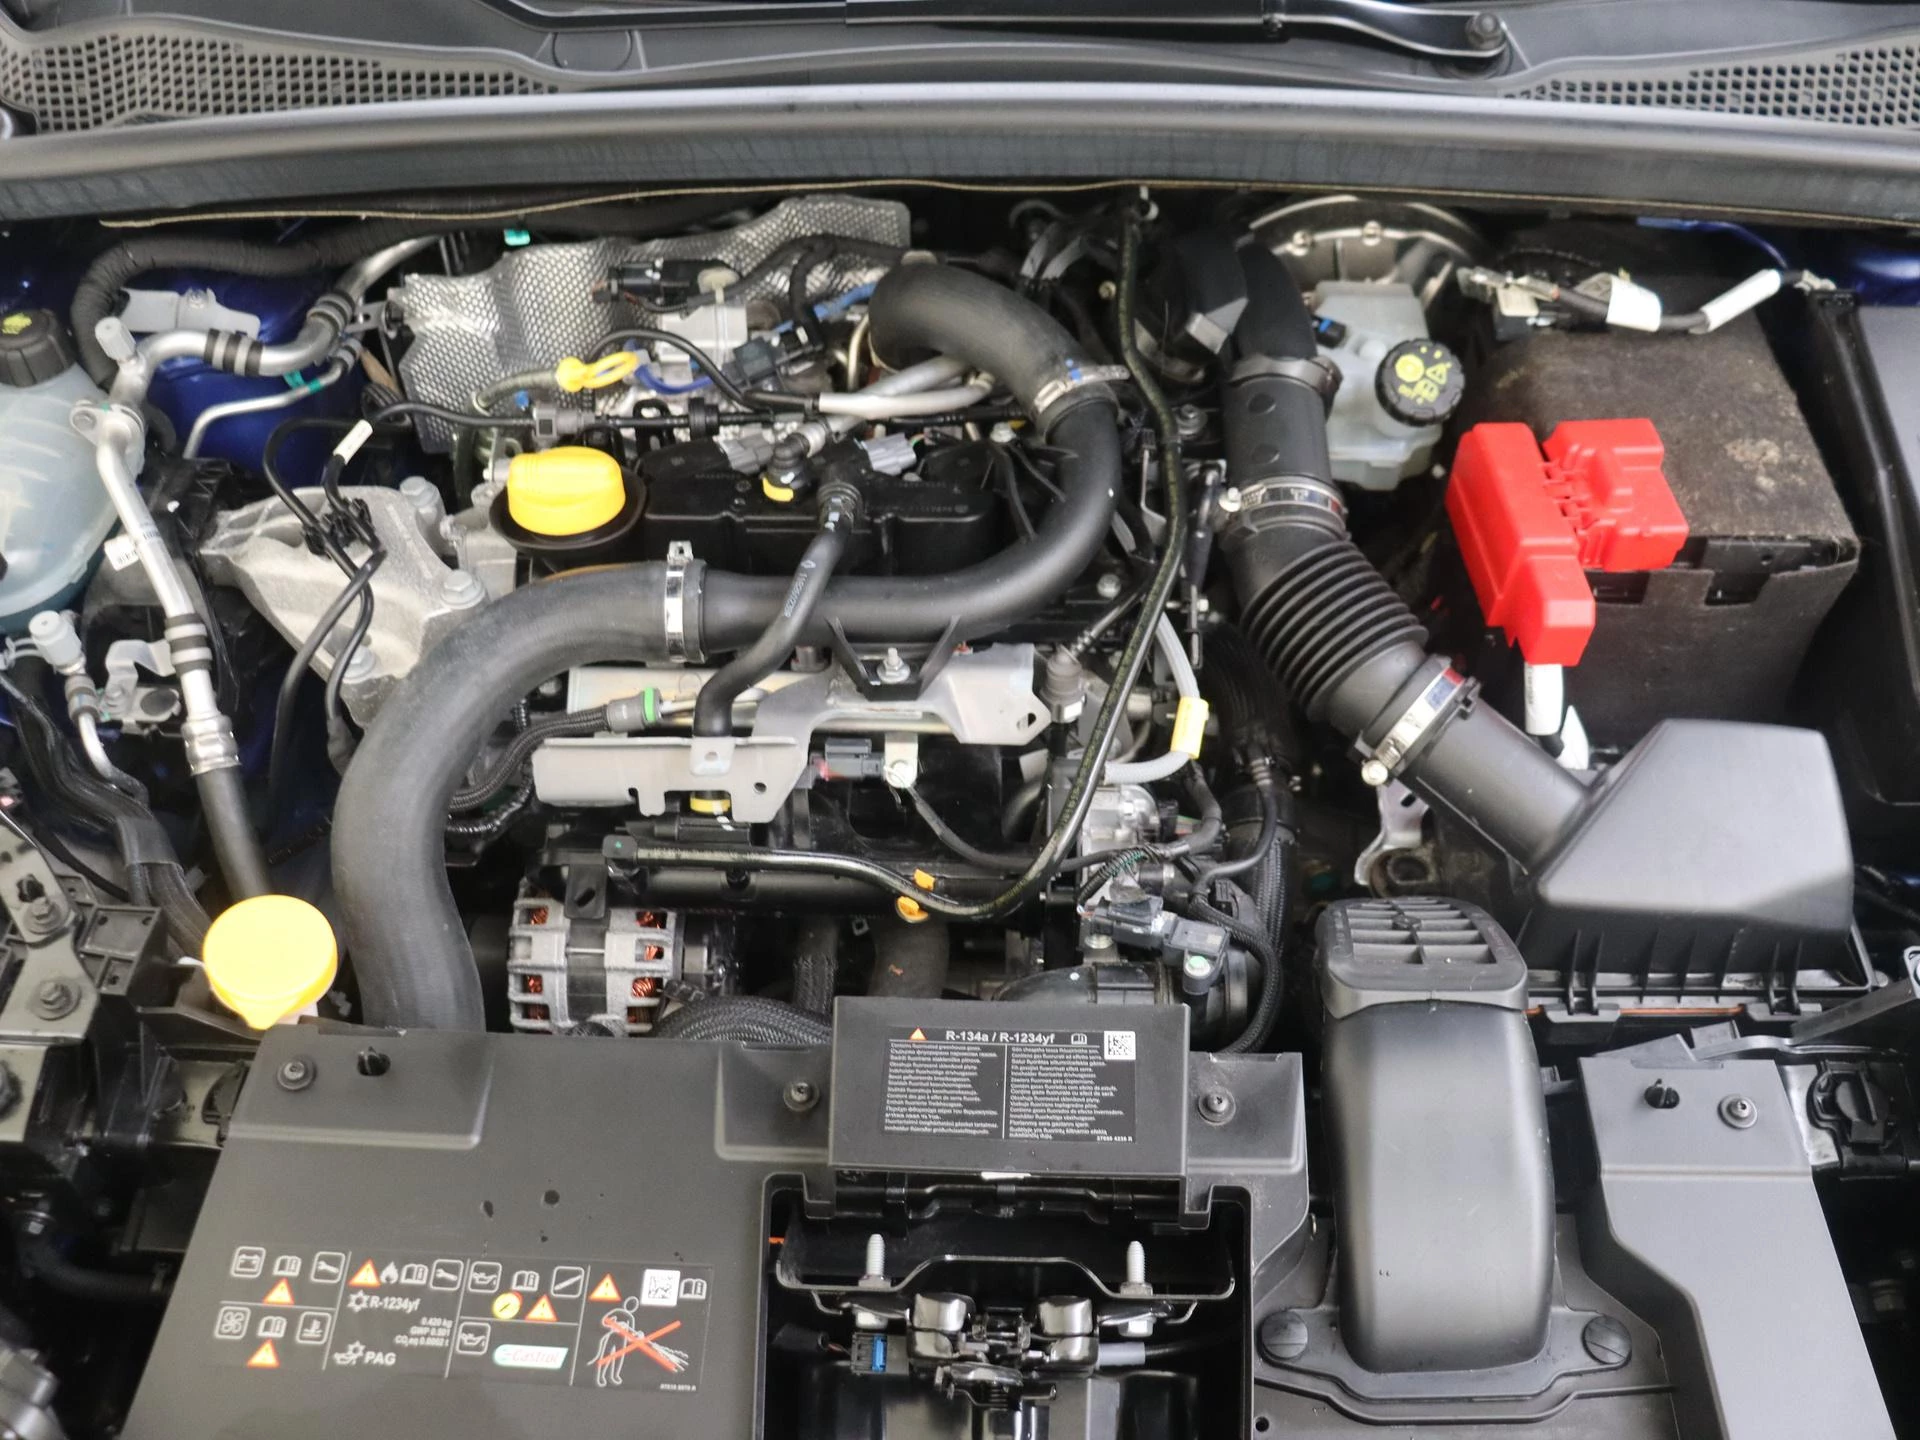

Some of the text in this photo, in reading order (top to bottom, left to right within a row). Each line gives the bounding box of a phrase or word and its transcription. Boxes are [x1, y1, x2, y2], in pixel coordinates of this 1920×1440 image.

[945, 1030, 1055, 1045] R-134a / R-1234yf
[369, 1296, 421, 1313] R-1234yf
[364, 1351, 396, 1366] PAG
